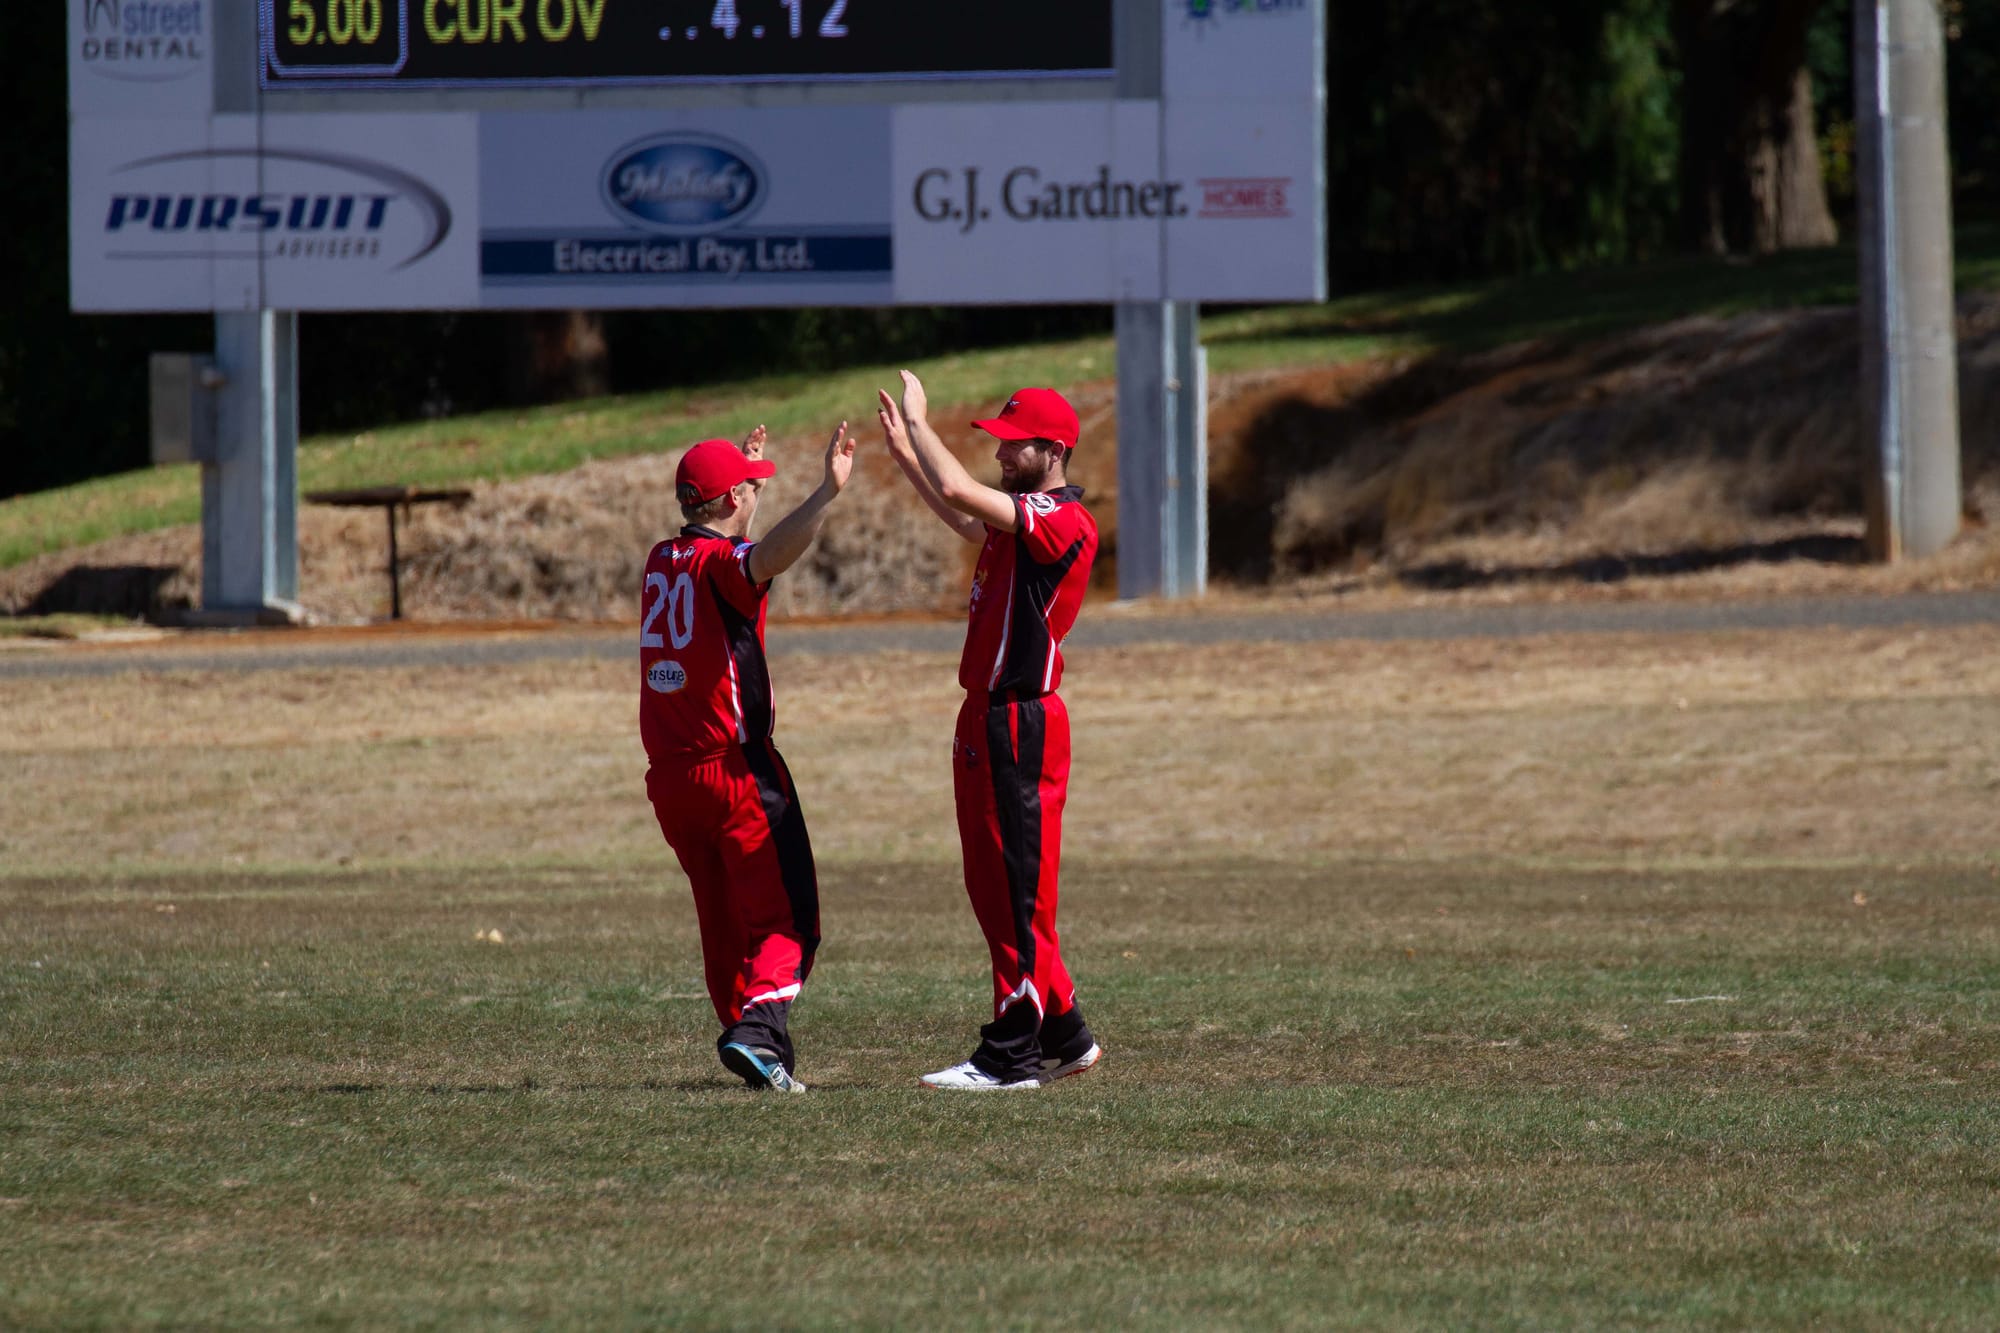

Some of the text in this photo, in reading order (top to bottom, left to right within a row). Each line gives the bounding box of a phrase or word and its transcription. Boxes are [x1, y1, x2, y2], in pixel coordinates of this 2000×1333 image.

[287, 0, 383, 45] 5.00
[424, 0, 527, 44] CUR
[537, 0, 606, 42] OV
[82, 37, 203, 61] DENTAL
[106, 195, 396, 231] PURSUIT
[913, 167, 989, 233] G.J.
[1203, 187, 1285, 210] HOMES
[553, 238, 690, 273] Electrical
[756, 236, 814, 272] Ltd.
[641, 572, 694, 649] 20
